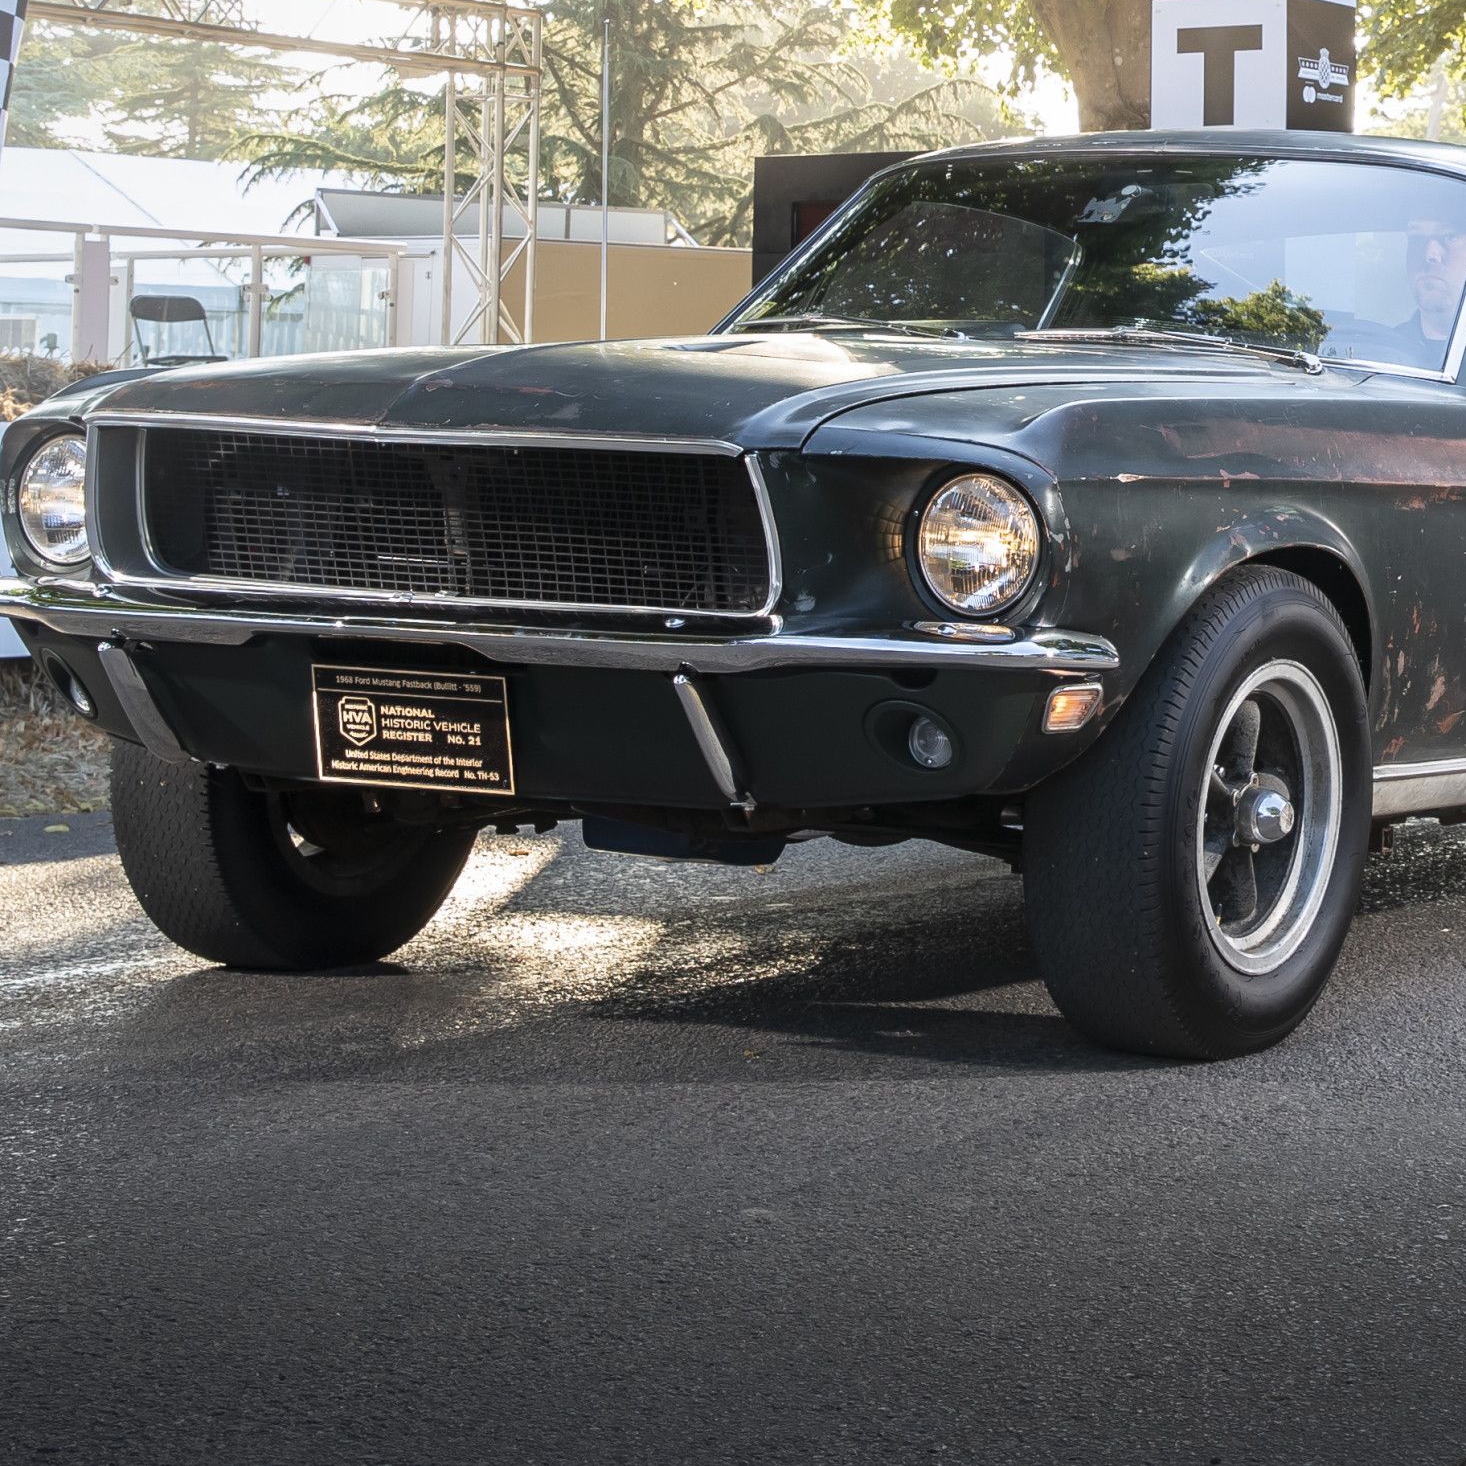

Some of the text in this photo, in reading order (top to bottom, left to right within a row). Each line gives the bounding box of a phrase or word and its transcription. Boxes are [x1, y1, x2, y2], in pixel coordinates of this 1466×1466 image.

[335, 675, 354, 684] 1968
[354, 676, 371, 685] Ford
[372, 678, 401, 689] Mustang
[402, 680, 432, 690] Fastback
[342, 710, 373, 724] HVA
[380, 705, 435, 719] NATIONAL
[381, 717, 481, 734] HISTORIC VEHICLE
[382, 730, 433, 743] REGISTER
[467, 735, 482, 746] 21
[345, 749, 483, 768] United States Department of the Interior
[331, 759, 358, 771] Historic
[358, 763, 392, 774] American
[392, 765, 434, 778] Engineering
[434, 768, 460, 779] Record
[463, 769, 477, 780] No.
